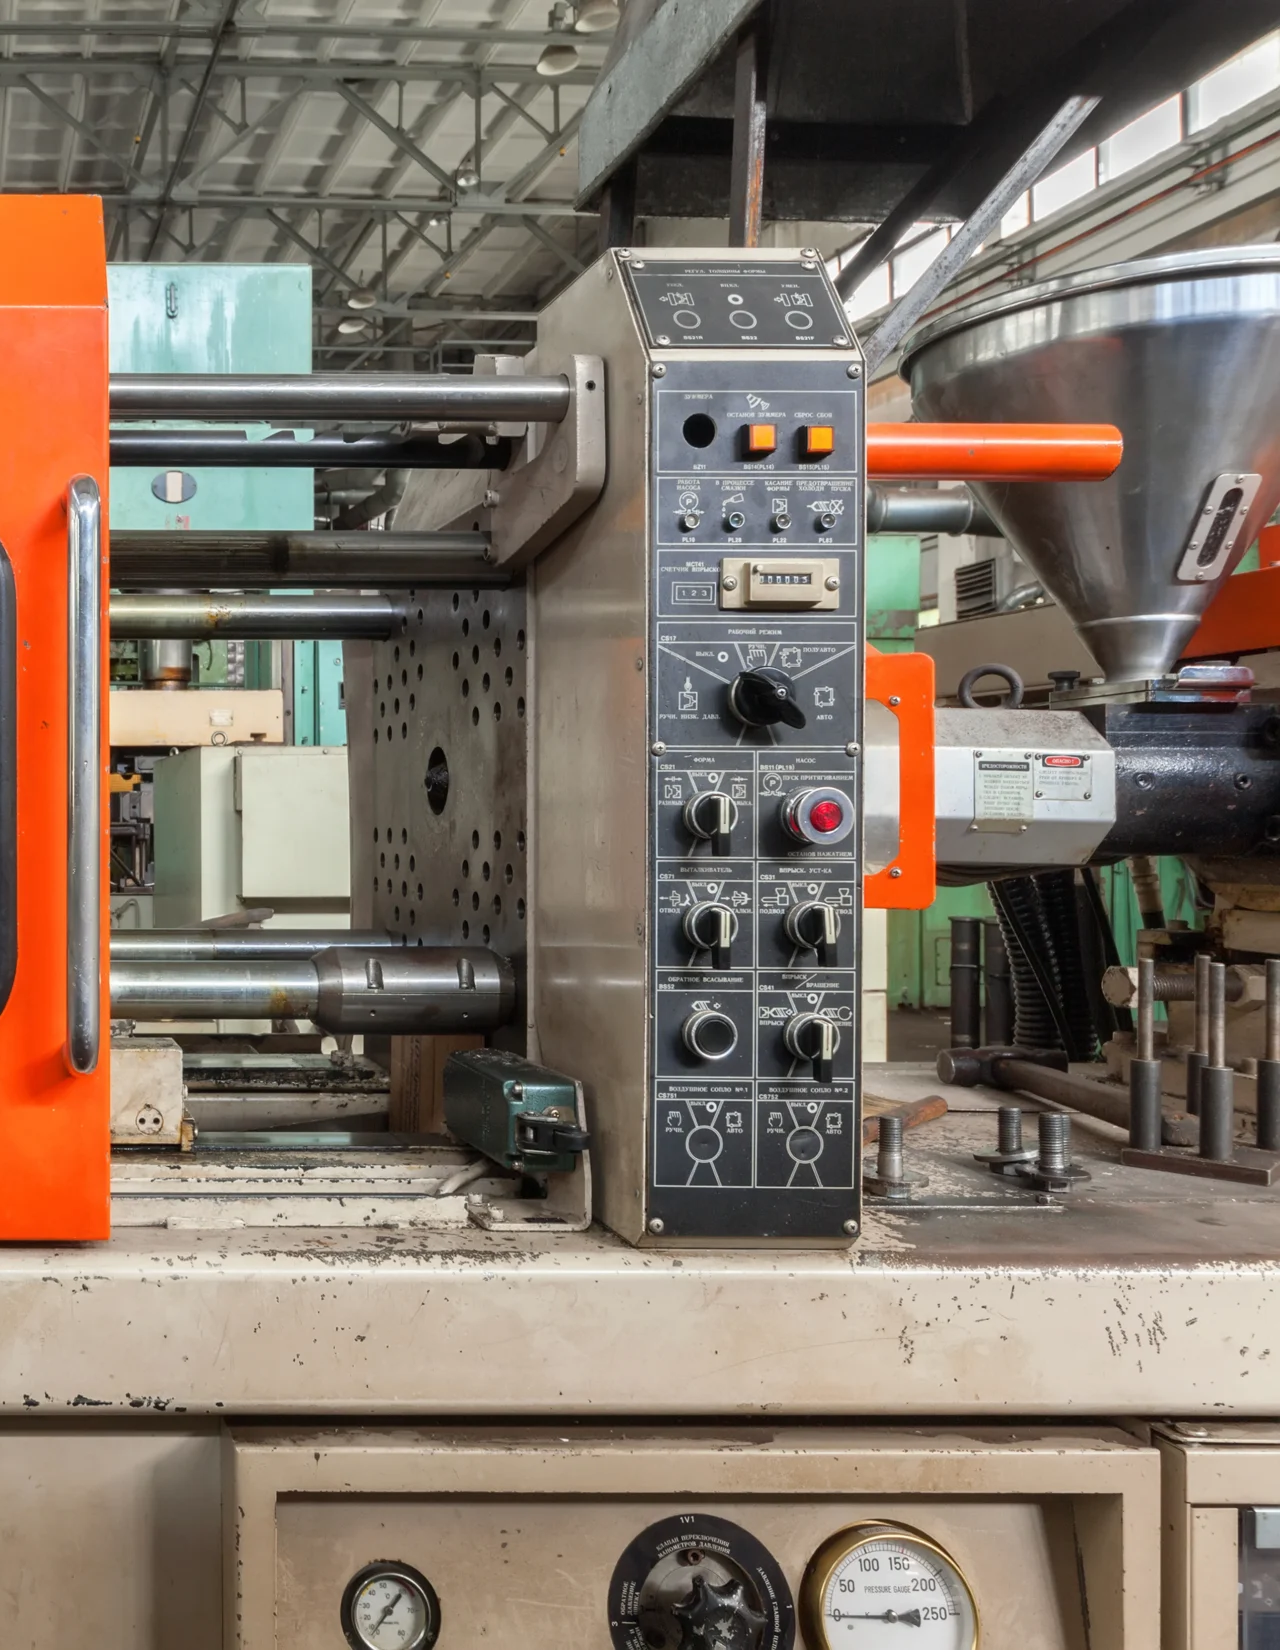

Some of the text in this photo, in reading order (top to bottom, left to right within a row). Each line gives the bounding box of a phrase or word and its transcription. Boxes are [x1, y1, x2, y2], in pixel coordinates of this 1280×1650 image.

[679, 1516, 695, 1524] 1V1
[656, 1533, 730, 1551] КЛАПАН ПЕРЕКЛЮЧЕНИЯ
[657, 1541, 731, 1558] МАНОМЕТРОВ ДАВЛЕНИЯ
[859, 1558, 880, 1572] 100
[889, 1557, 910, 1571] 150
[839, 1579, 855, 1593] 50
[864, 1586, 911, 1594] PRESSURE GAUGE
[911, 1578, 936, 1592] 200
[620, 1581, 629, 1616] ОБРАТНОЕ
[627, 1581, 637, 1616] ДАВЛЕНИЕ
[756, 1566, 782, 1633] ДАВЛЕНИЕ ГЛАВНОЙ
[833, 1608, 841, 1622] 0
[922, 1607, 948, 1621] 250
